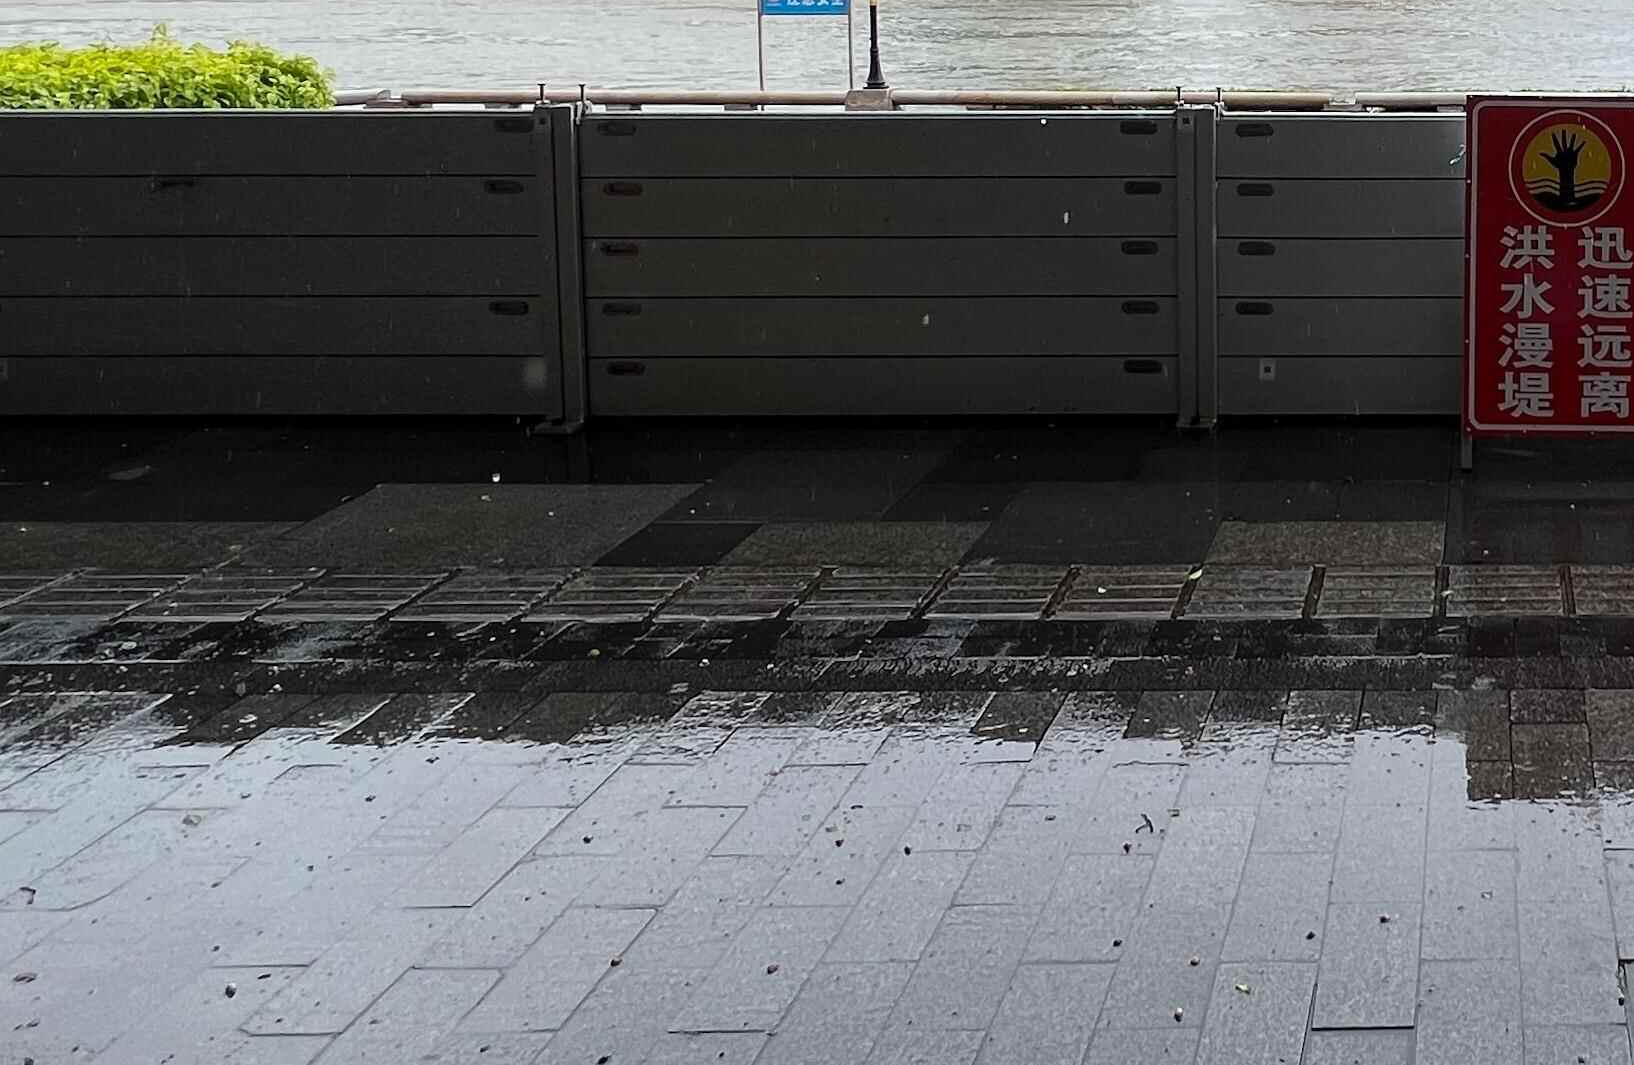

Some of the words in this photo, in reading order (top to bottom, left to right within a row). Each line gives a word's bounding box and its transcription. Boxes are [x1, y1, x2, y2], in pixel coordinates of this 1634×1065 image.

[1498, 224, 1556, 418] 洪水漫堤
[1577, 226, 1634, 419] 迅速远离
